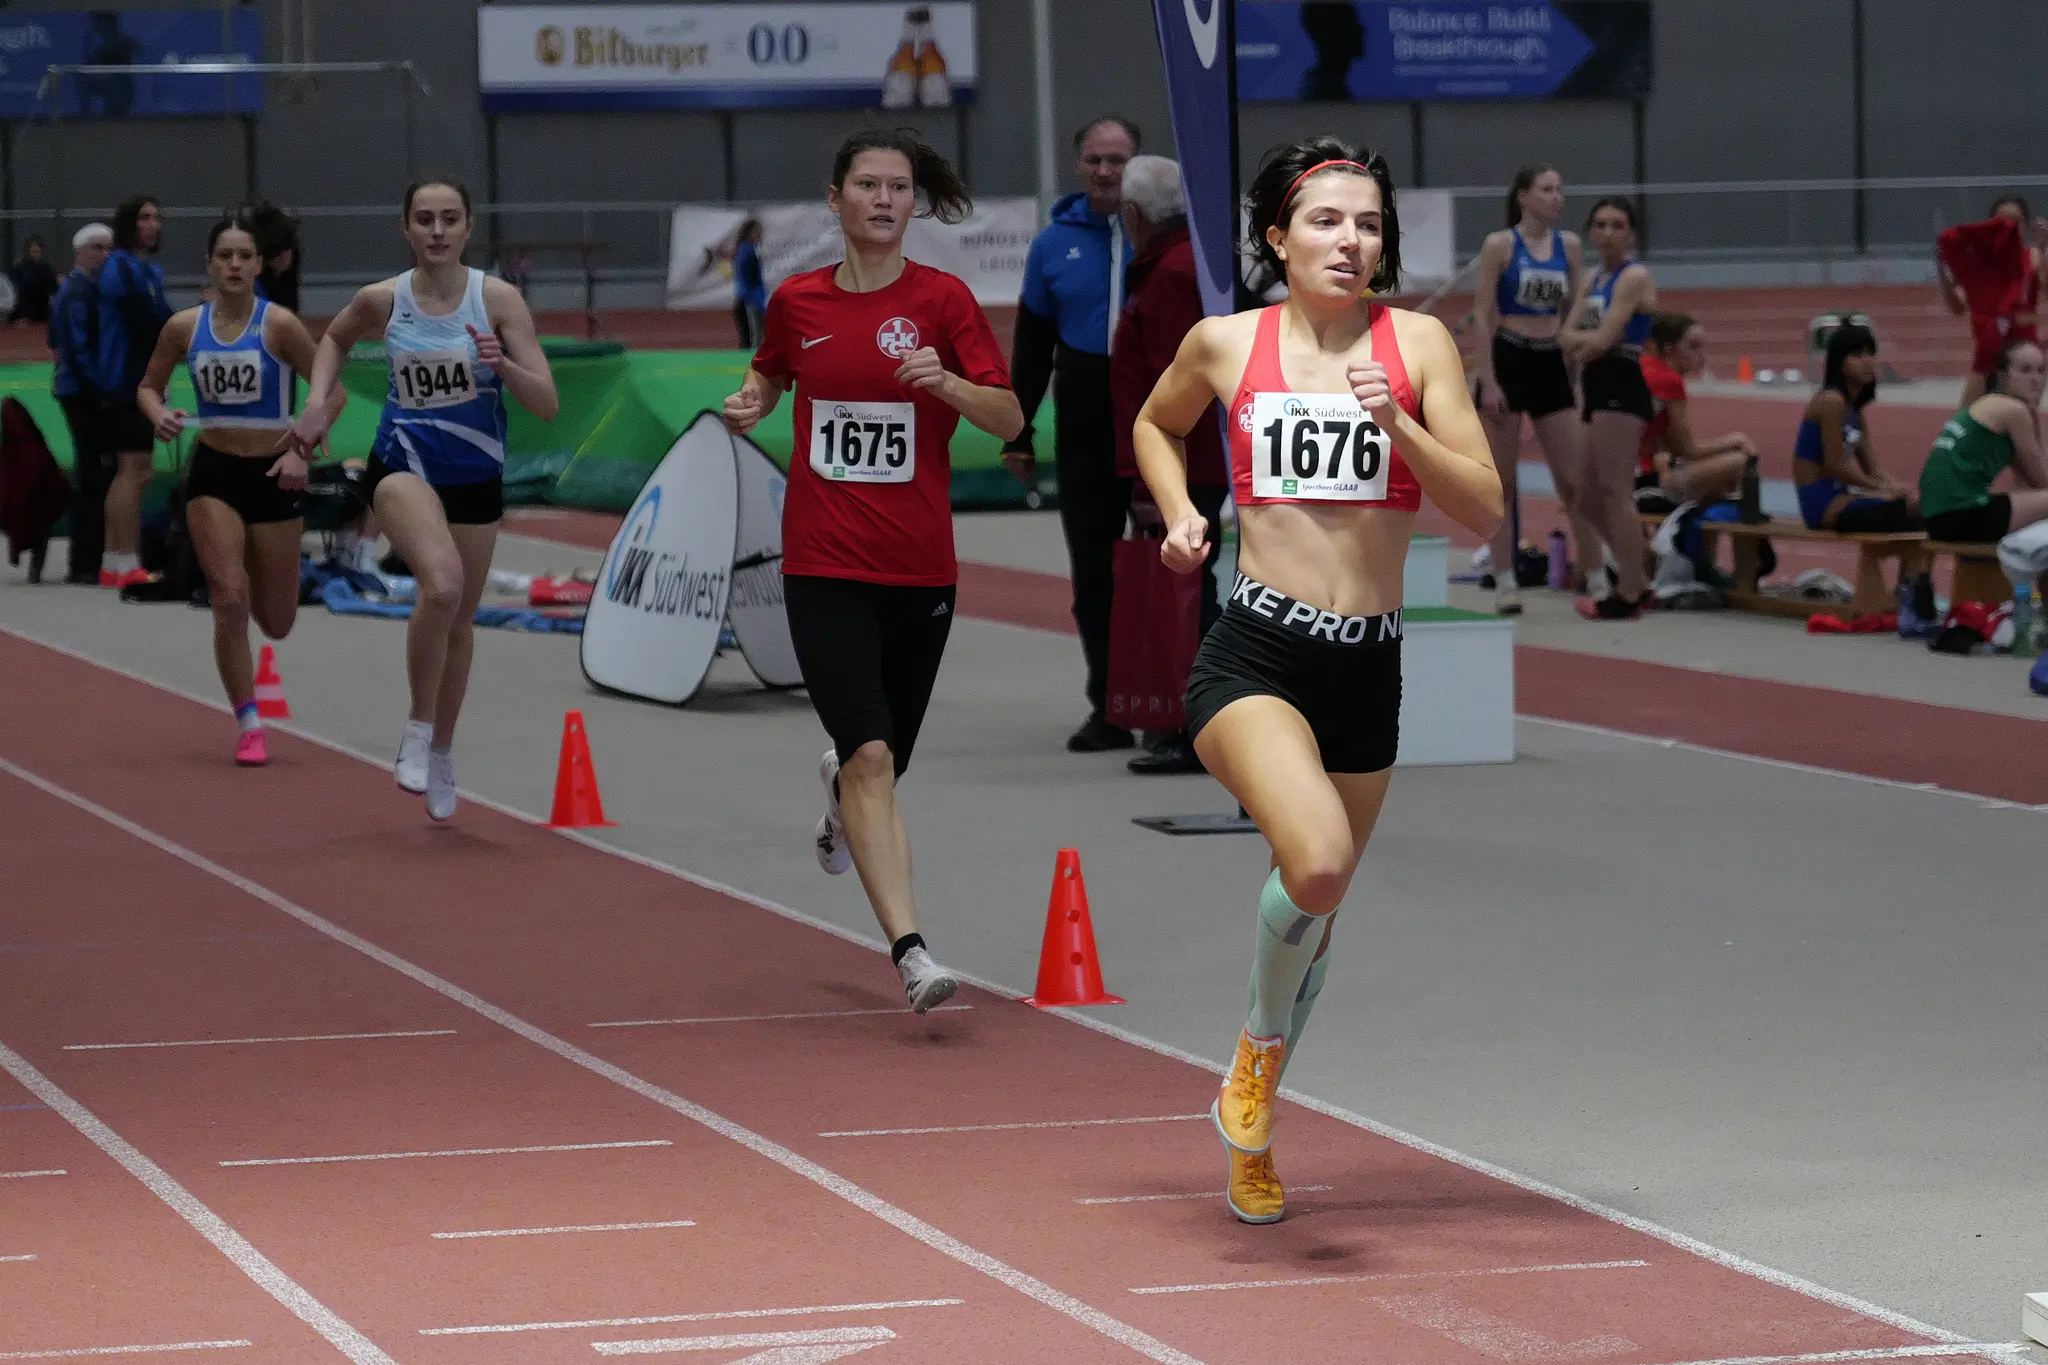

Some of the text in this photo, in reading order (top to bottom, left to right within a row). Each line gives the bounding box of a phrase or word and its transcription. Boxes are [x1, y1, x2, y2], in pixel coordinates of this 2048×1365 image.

[571, 25, 711, 73] Bitburger
[200, 364, 256, 394] 1842
[400, 363, 469, 397] 1944
[856, 412, 892, 421] Südwest
[1314, 407, 1362, 419] Südwest
[820, 420, 906, 468] 1675
[1263, 418, 1381, 481] 1676
[1302, 483, 1332, 492] Sporthaus
[1333, 483, 1359, 492] GLAAB
[644, 552, 725, 622] Südwest
[1282, 601, 1367, 644] PRO
